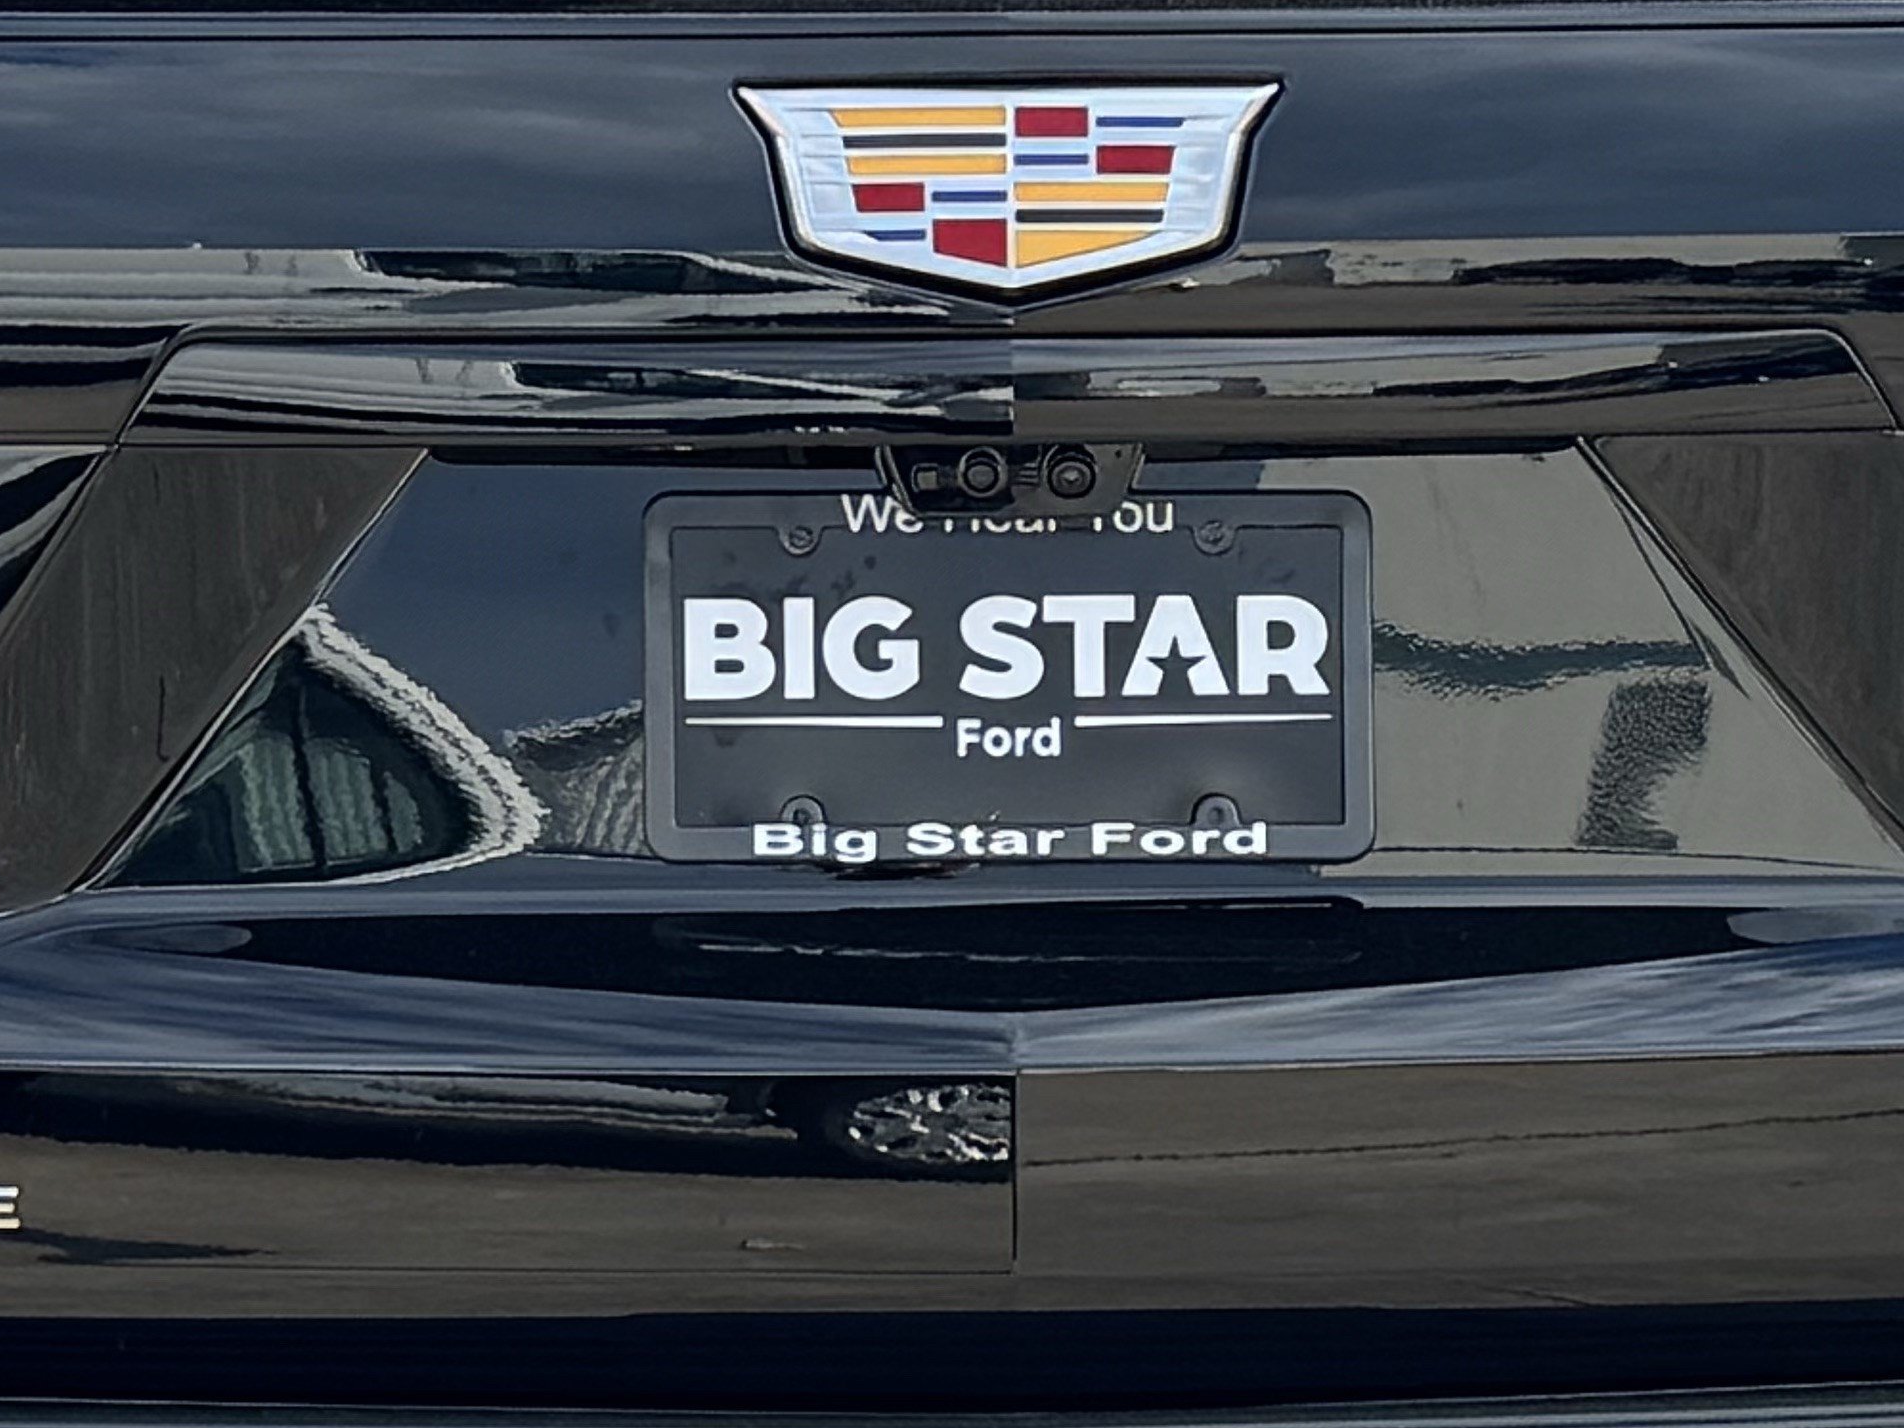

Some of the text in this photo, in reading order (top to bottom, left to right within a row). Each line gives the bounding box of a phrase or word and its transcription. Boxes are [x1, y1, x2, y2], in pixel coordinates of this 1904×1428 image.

[683, 594, 1330, 701] BIG STAR
[956, 717, 1062, 758] Ford
[753, 822, 1267, 863] Big Star Ford
